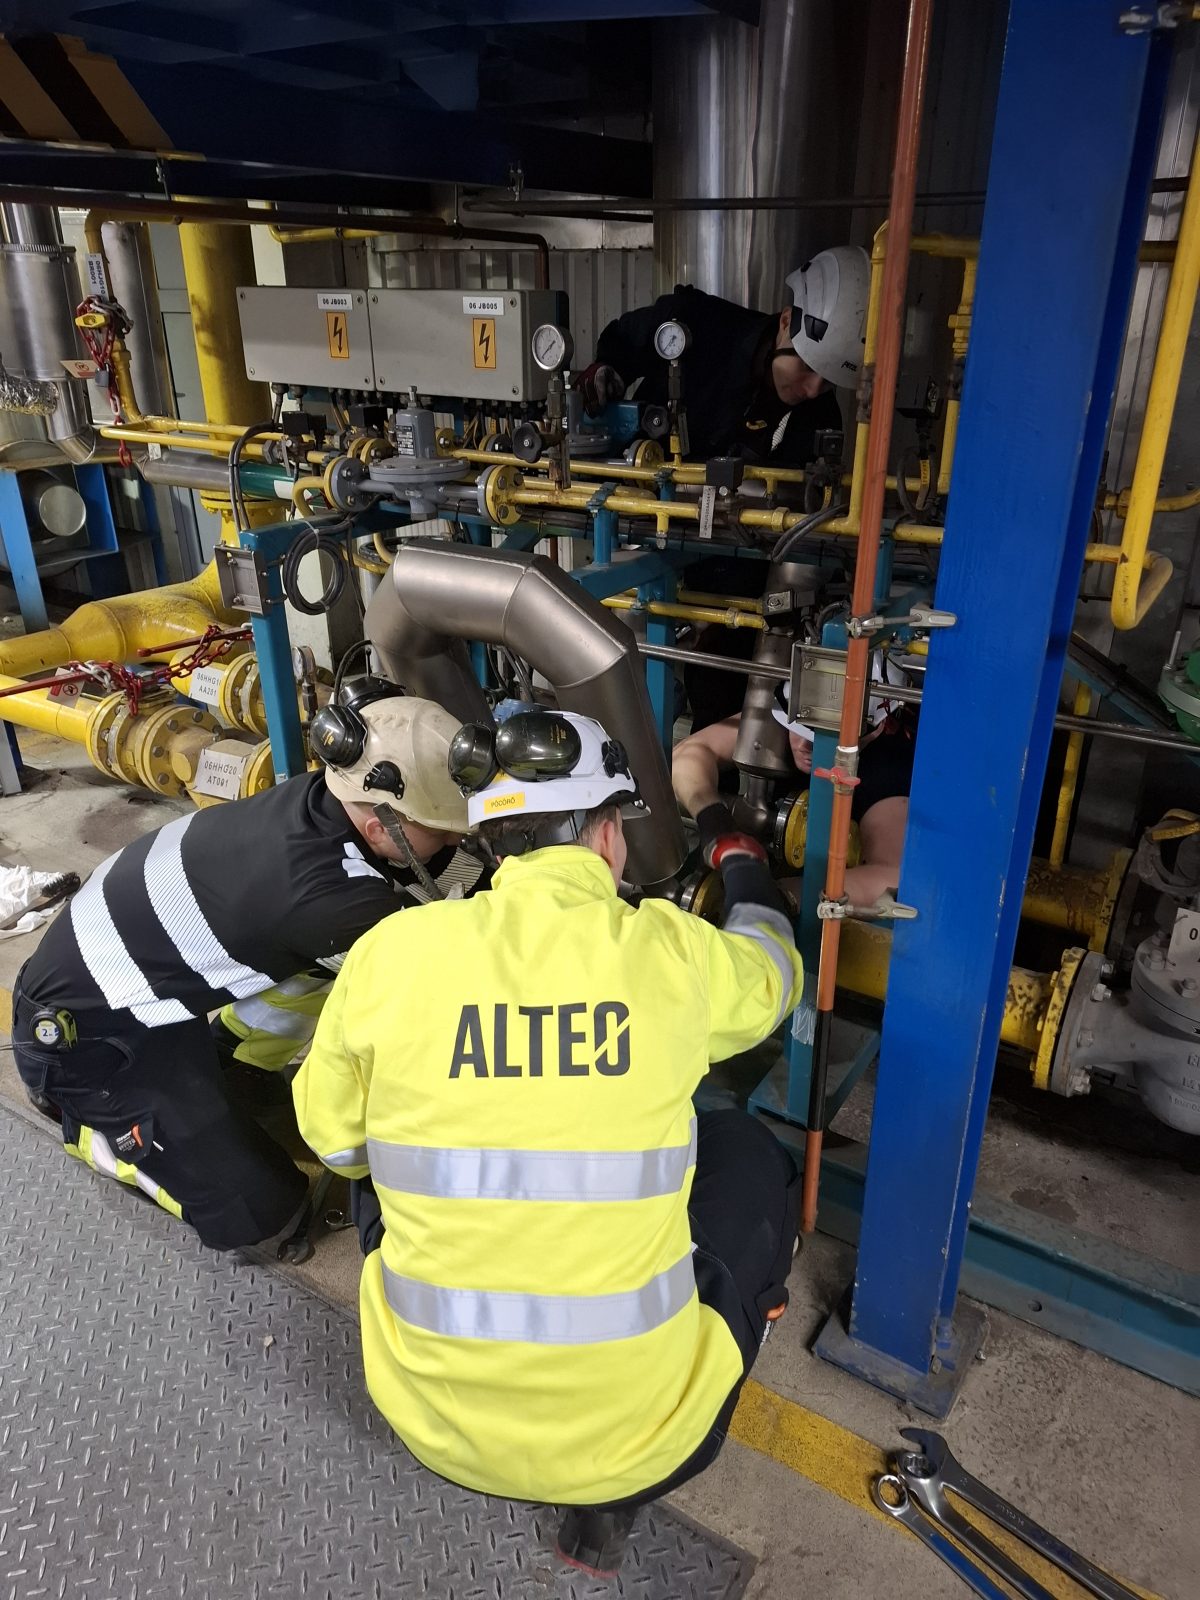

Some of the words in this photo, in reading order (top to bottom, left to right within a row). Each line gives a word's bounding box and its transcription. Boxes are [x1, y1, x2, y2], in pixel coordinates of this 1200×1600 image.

[478, 302, 498, 310] JB005
[204, 760, 238, 775] 06HHG20
[206, 775, 229, 787] AT001
[448, 1001, 630, 1078] ALTEO
